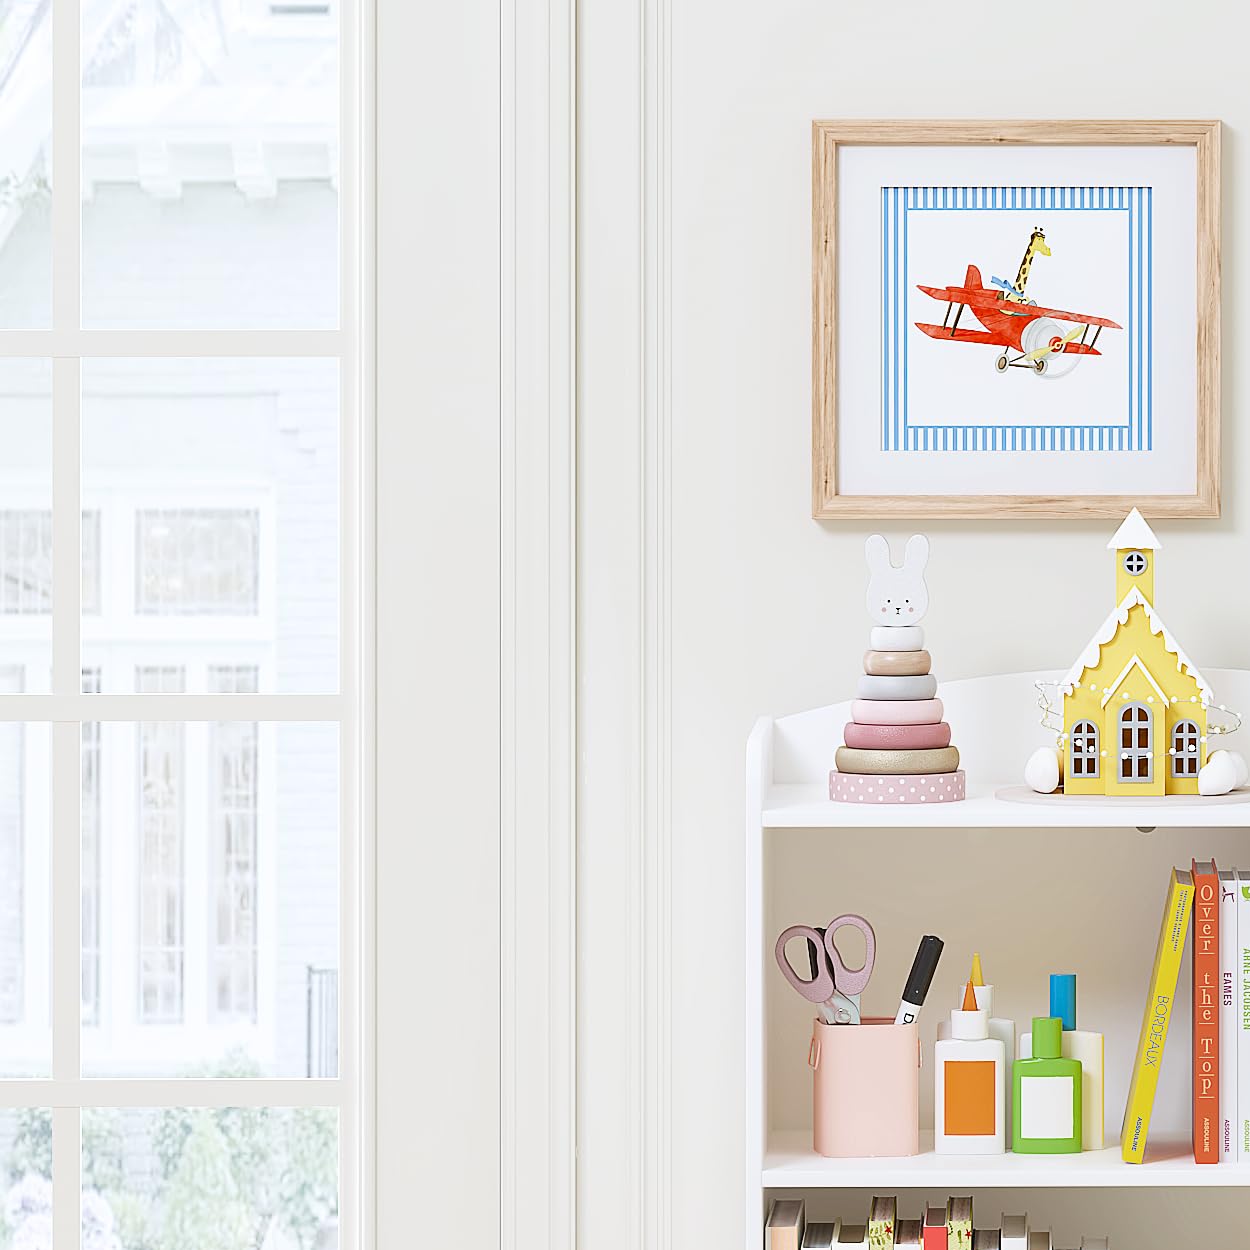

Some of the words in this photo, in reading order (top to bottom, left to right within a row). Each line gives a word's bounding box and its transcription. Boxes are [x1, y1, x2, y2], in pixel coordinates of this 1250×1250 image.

[1200, 884, 1214, 951] Over
[1201, 972, 1213, 1021] the
[1223, 972, 1232, 1006] EAMES
[1145, 995, 1169, 1068] BORDEAUX
[1201, 1038, 1213, 1095] Top
[1131, 1116, 1143, 1152] ASSOULINE
